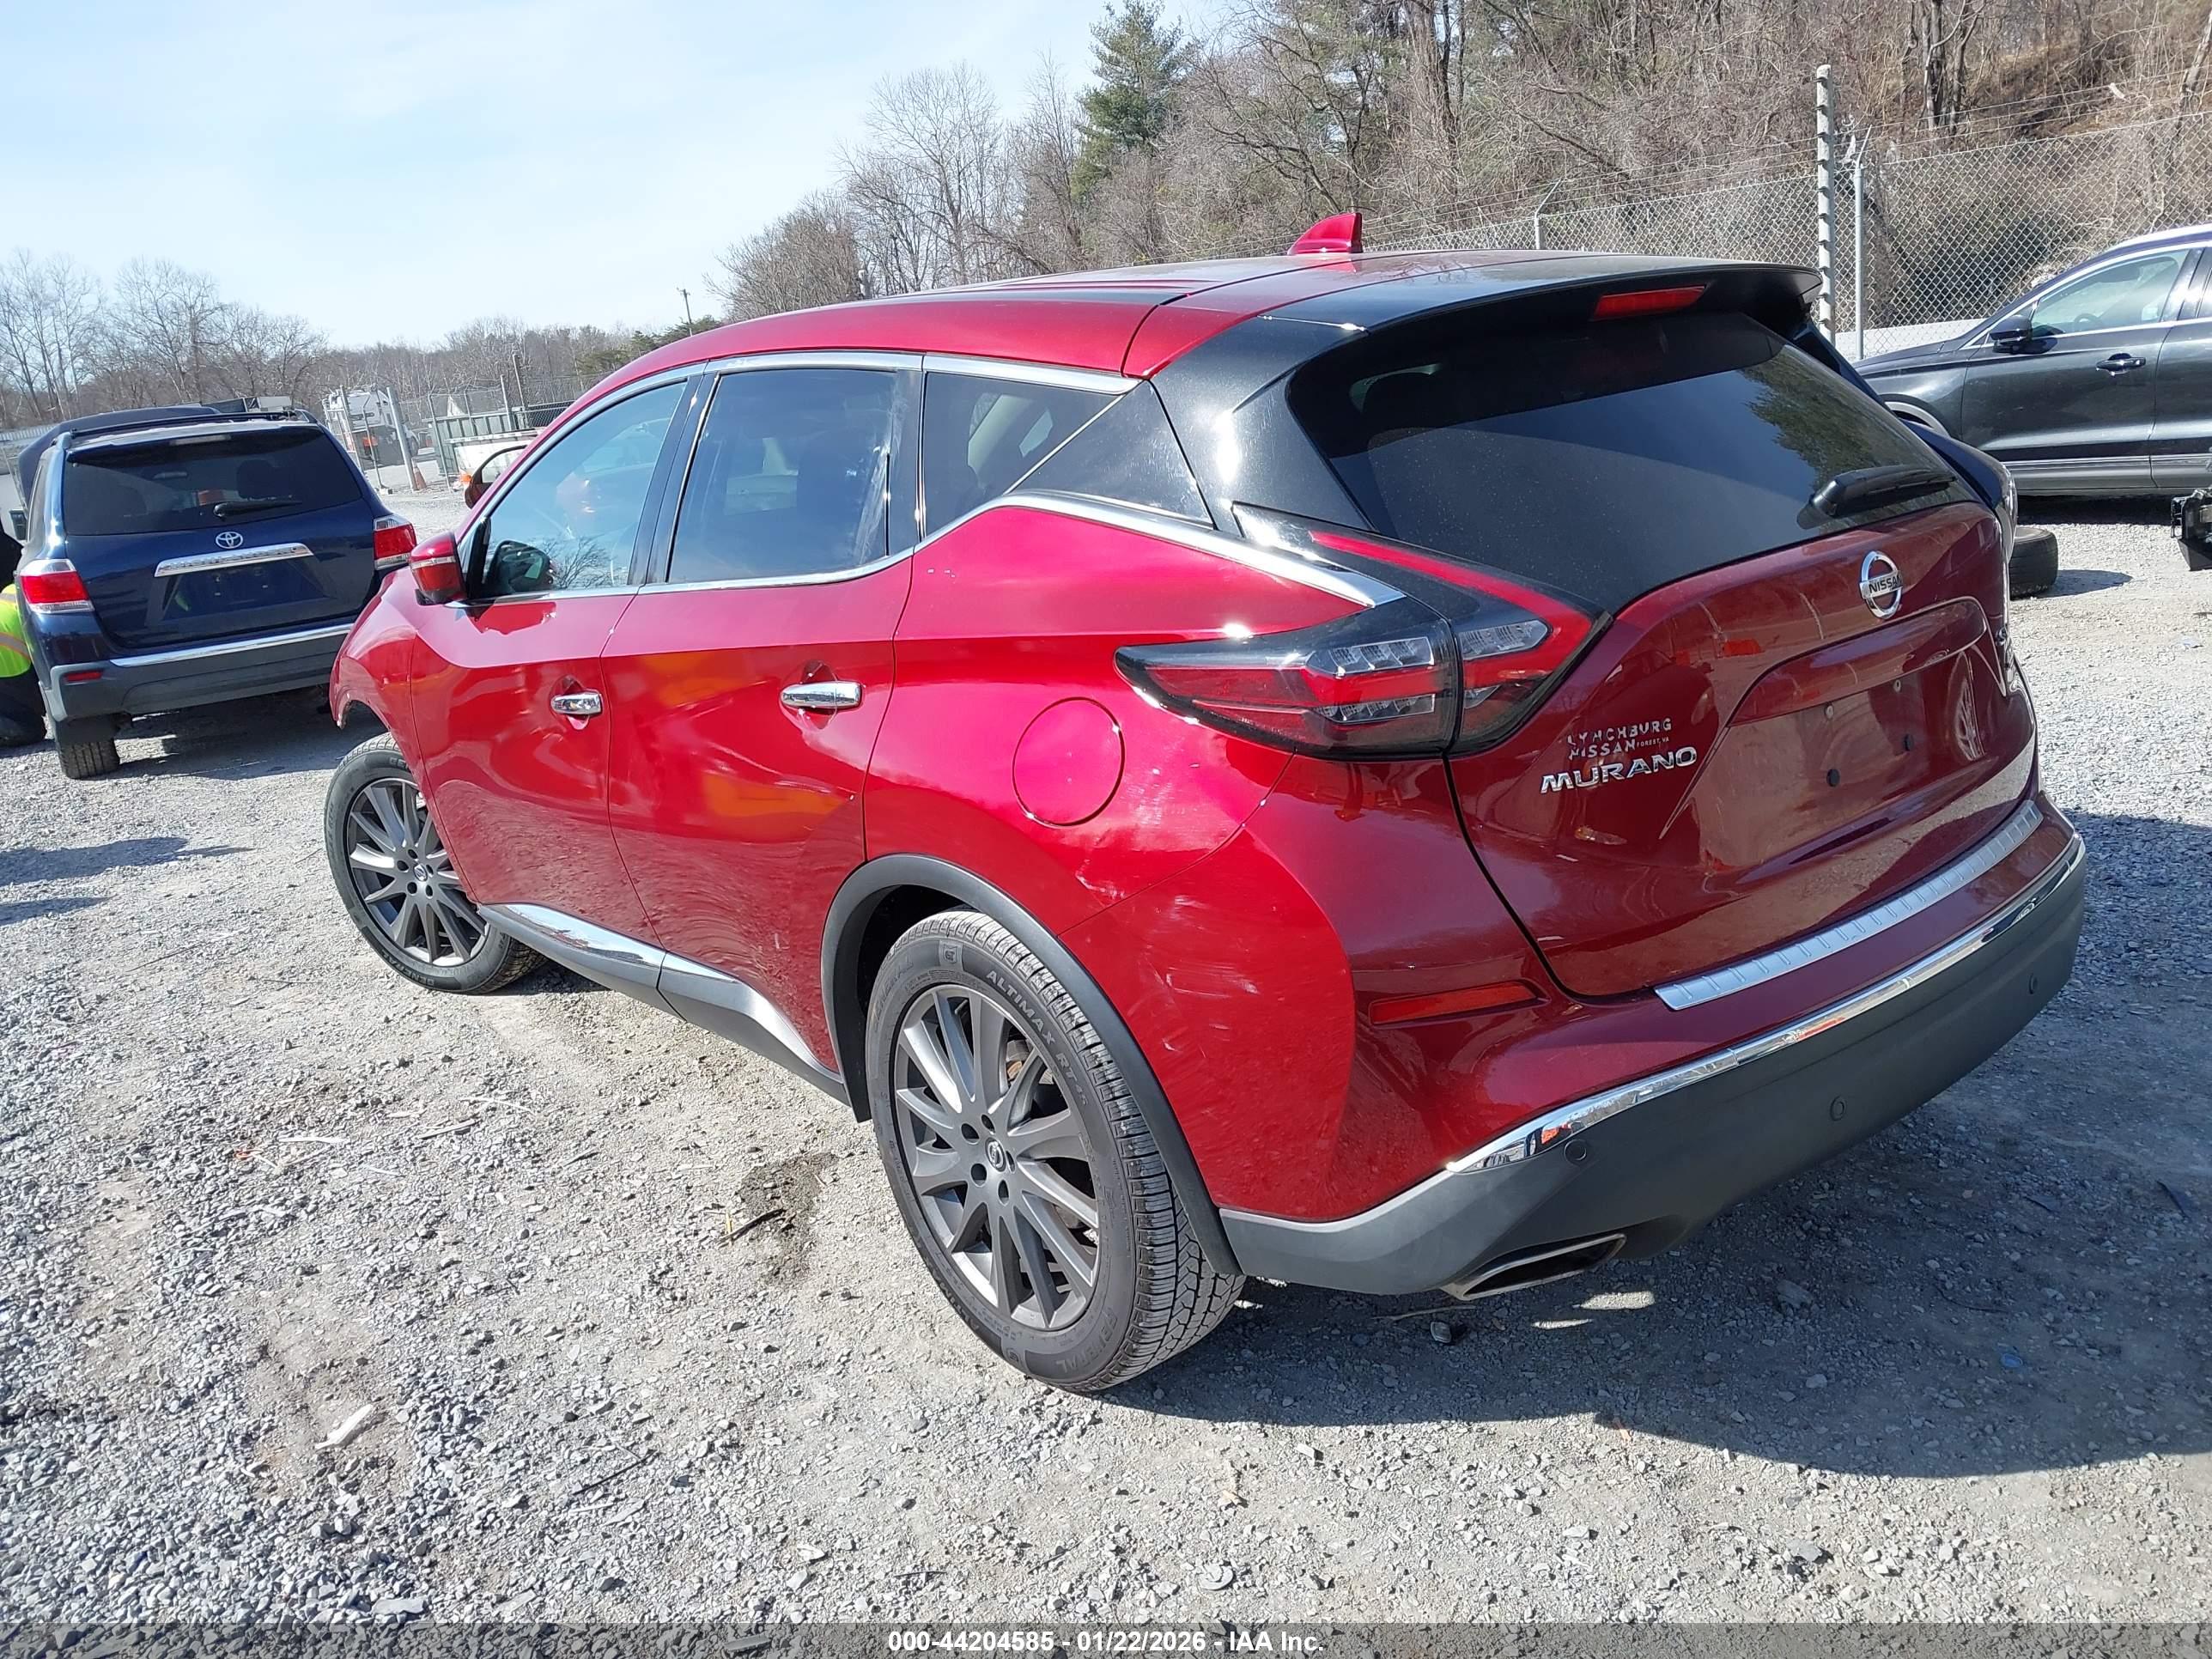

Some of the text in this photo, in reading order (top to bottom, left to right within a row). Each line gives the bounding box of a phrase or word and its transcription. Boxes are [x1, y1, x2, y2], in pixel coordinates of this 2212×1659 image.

[1869, 574, 1902, 594] NISSAN
[1567, 718, 1673, 746] LYNCHBURG
[1568, 738, 1636, 761] NISSAN
[1540, 746, 1698, 793] MURANO
[987, 970, 1056, 1045] ALTIMAX
